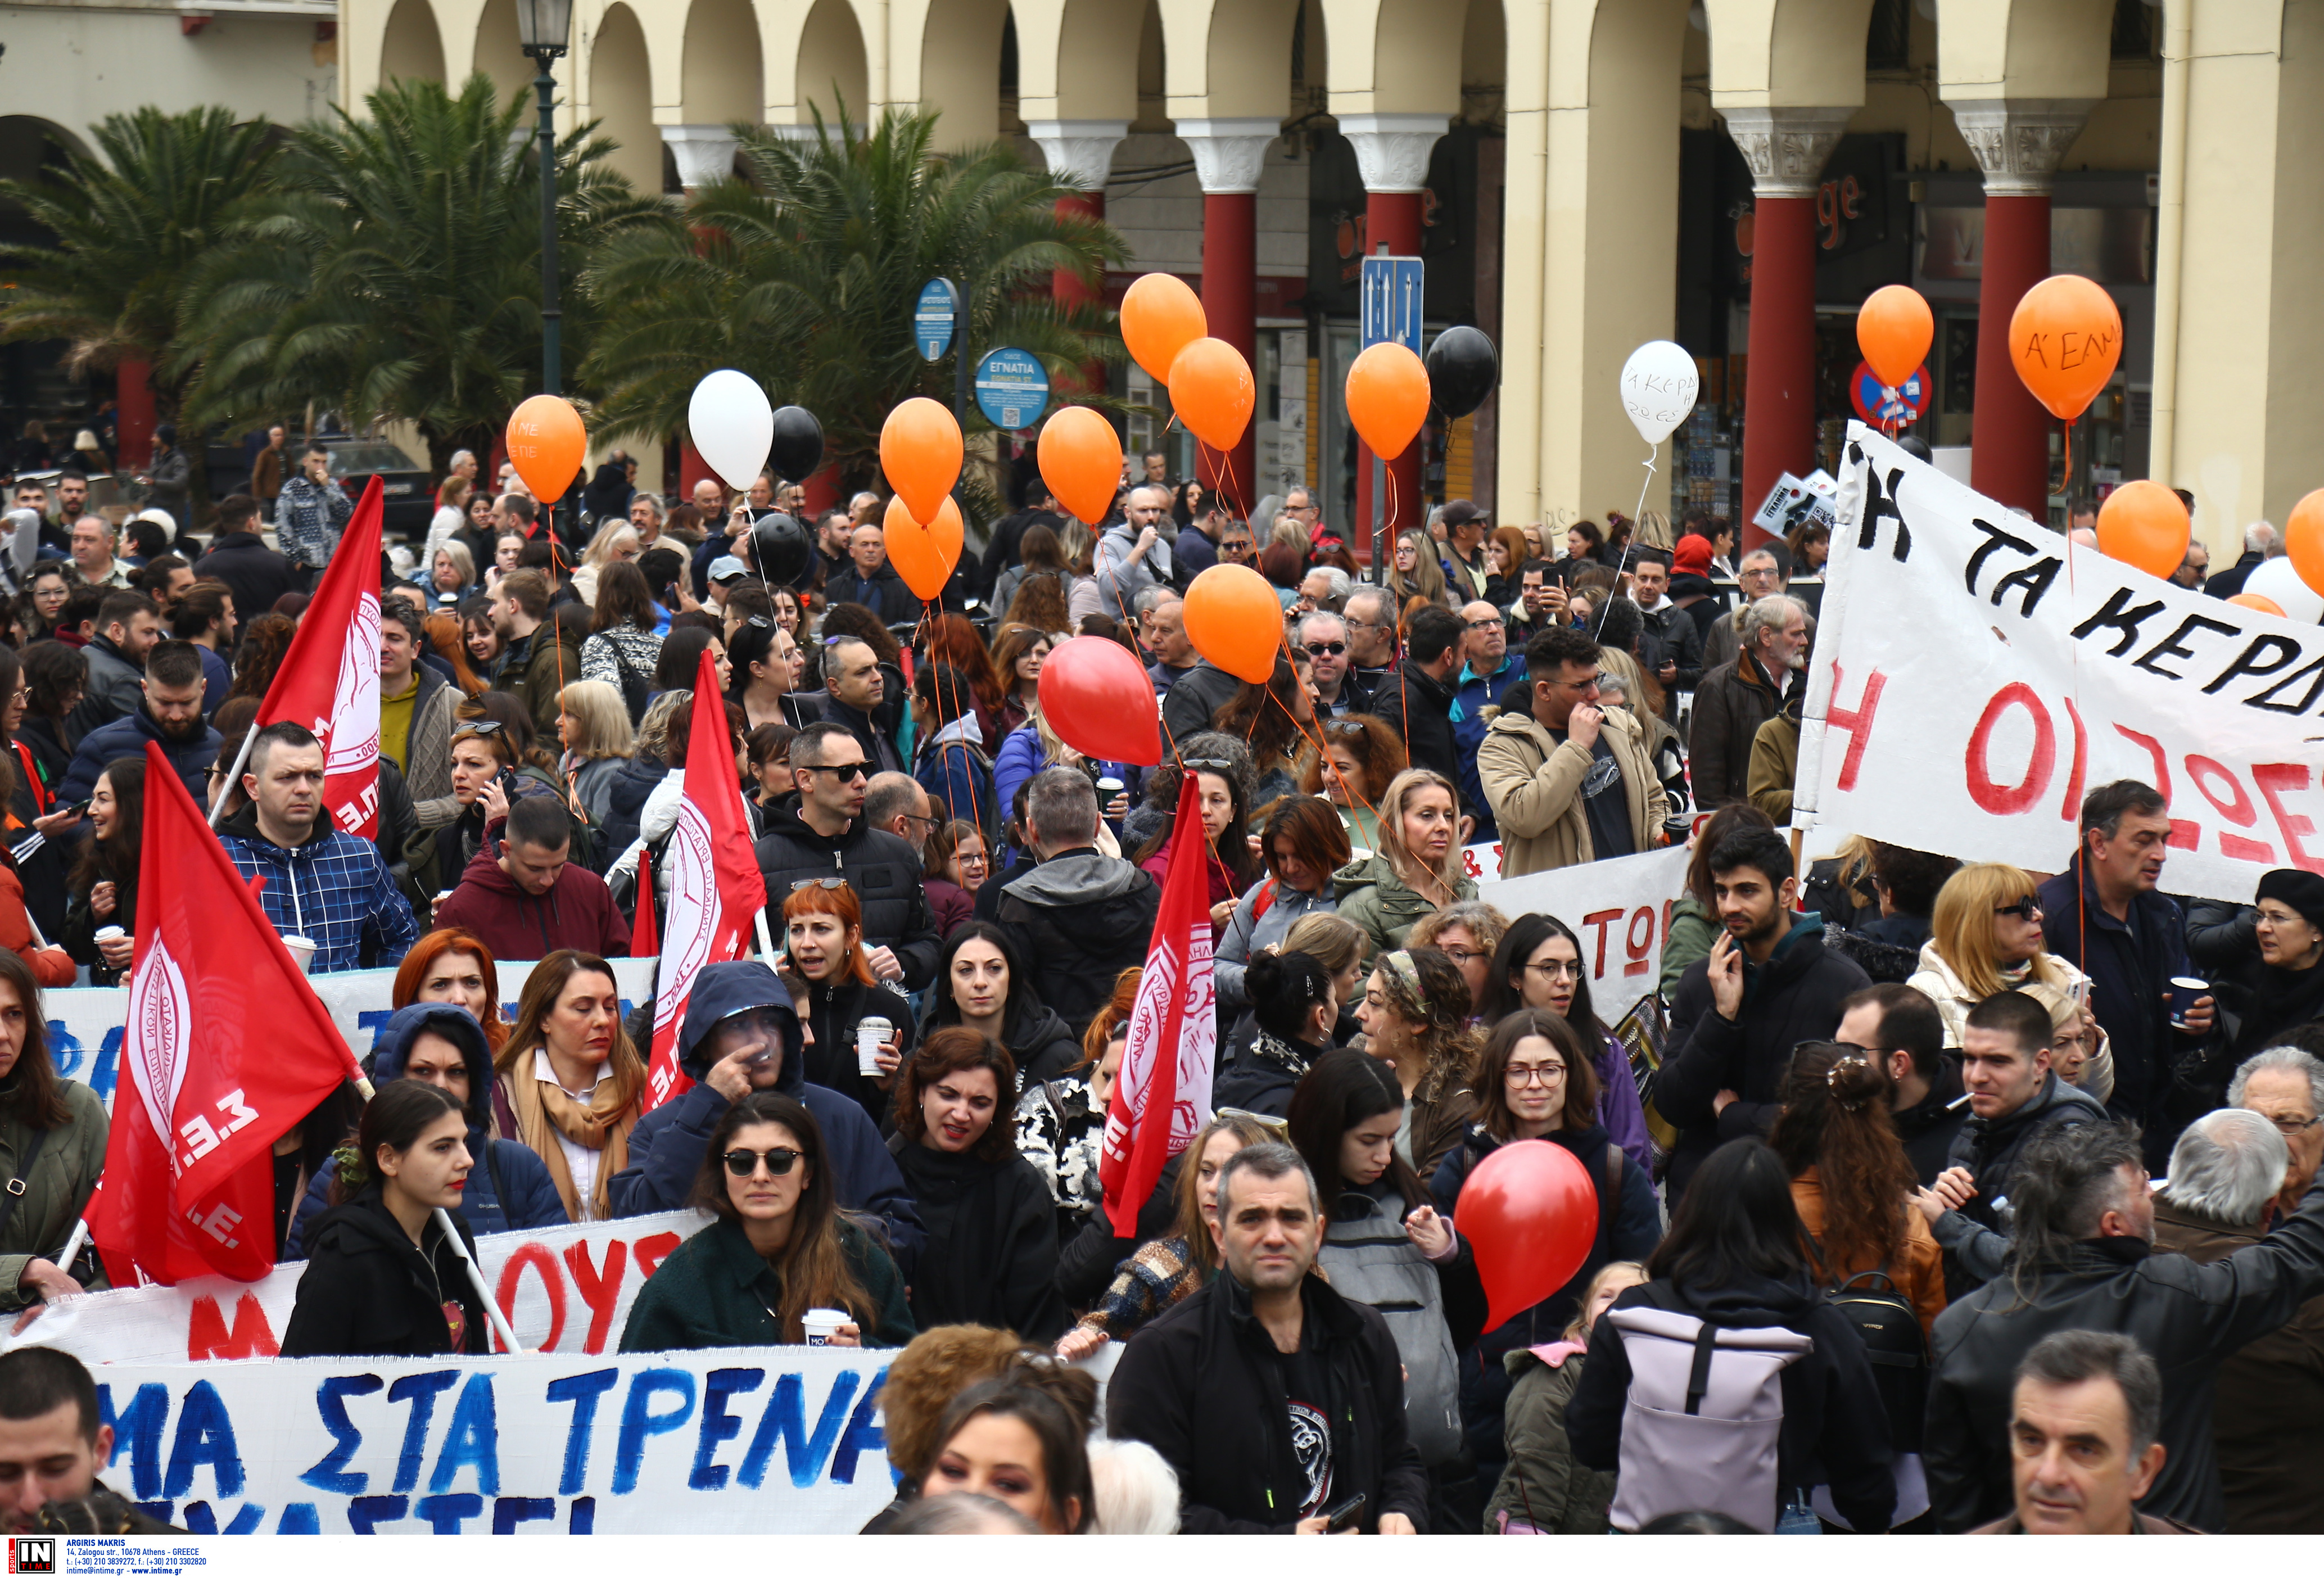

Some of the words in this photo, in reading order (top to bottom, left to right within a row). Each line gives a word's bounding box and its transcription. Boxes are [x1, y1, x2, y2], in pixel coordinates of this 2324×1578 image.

[990, 362, 1034, 374] ΕΓΝΑΤΙΑ
[2061, 324, 2120, 370] ΕΛΜ
[1966, 518, 2064, 618] ΤΑ
[2070, 587, 2324, 717] ΚΕΡΔ
[1965, 681, 2088, 822] ΟΙ
[2112, 721, 2324, 877] ΖΩΕ
[299, 1369, 500, 1497] ΣΤΑ
